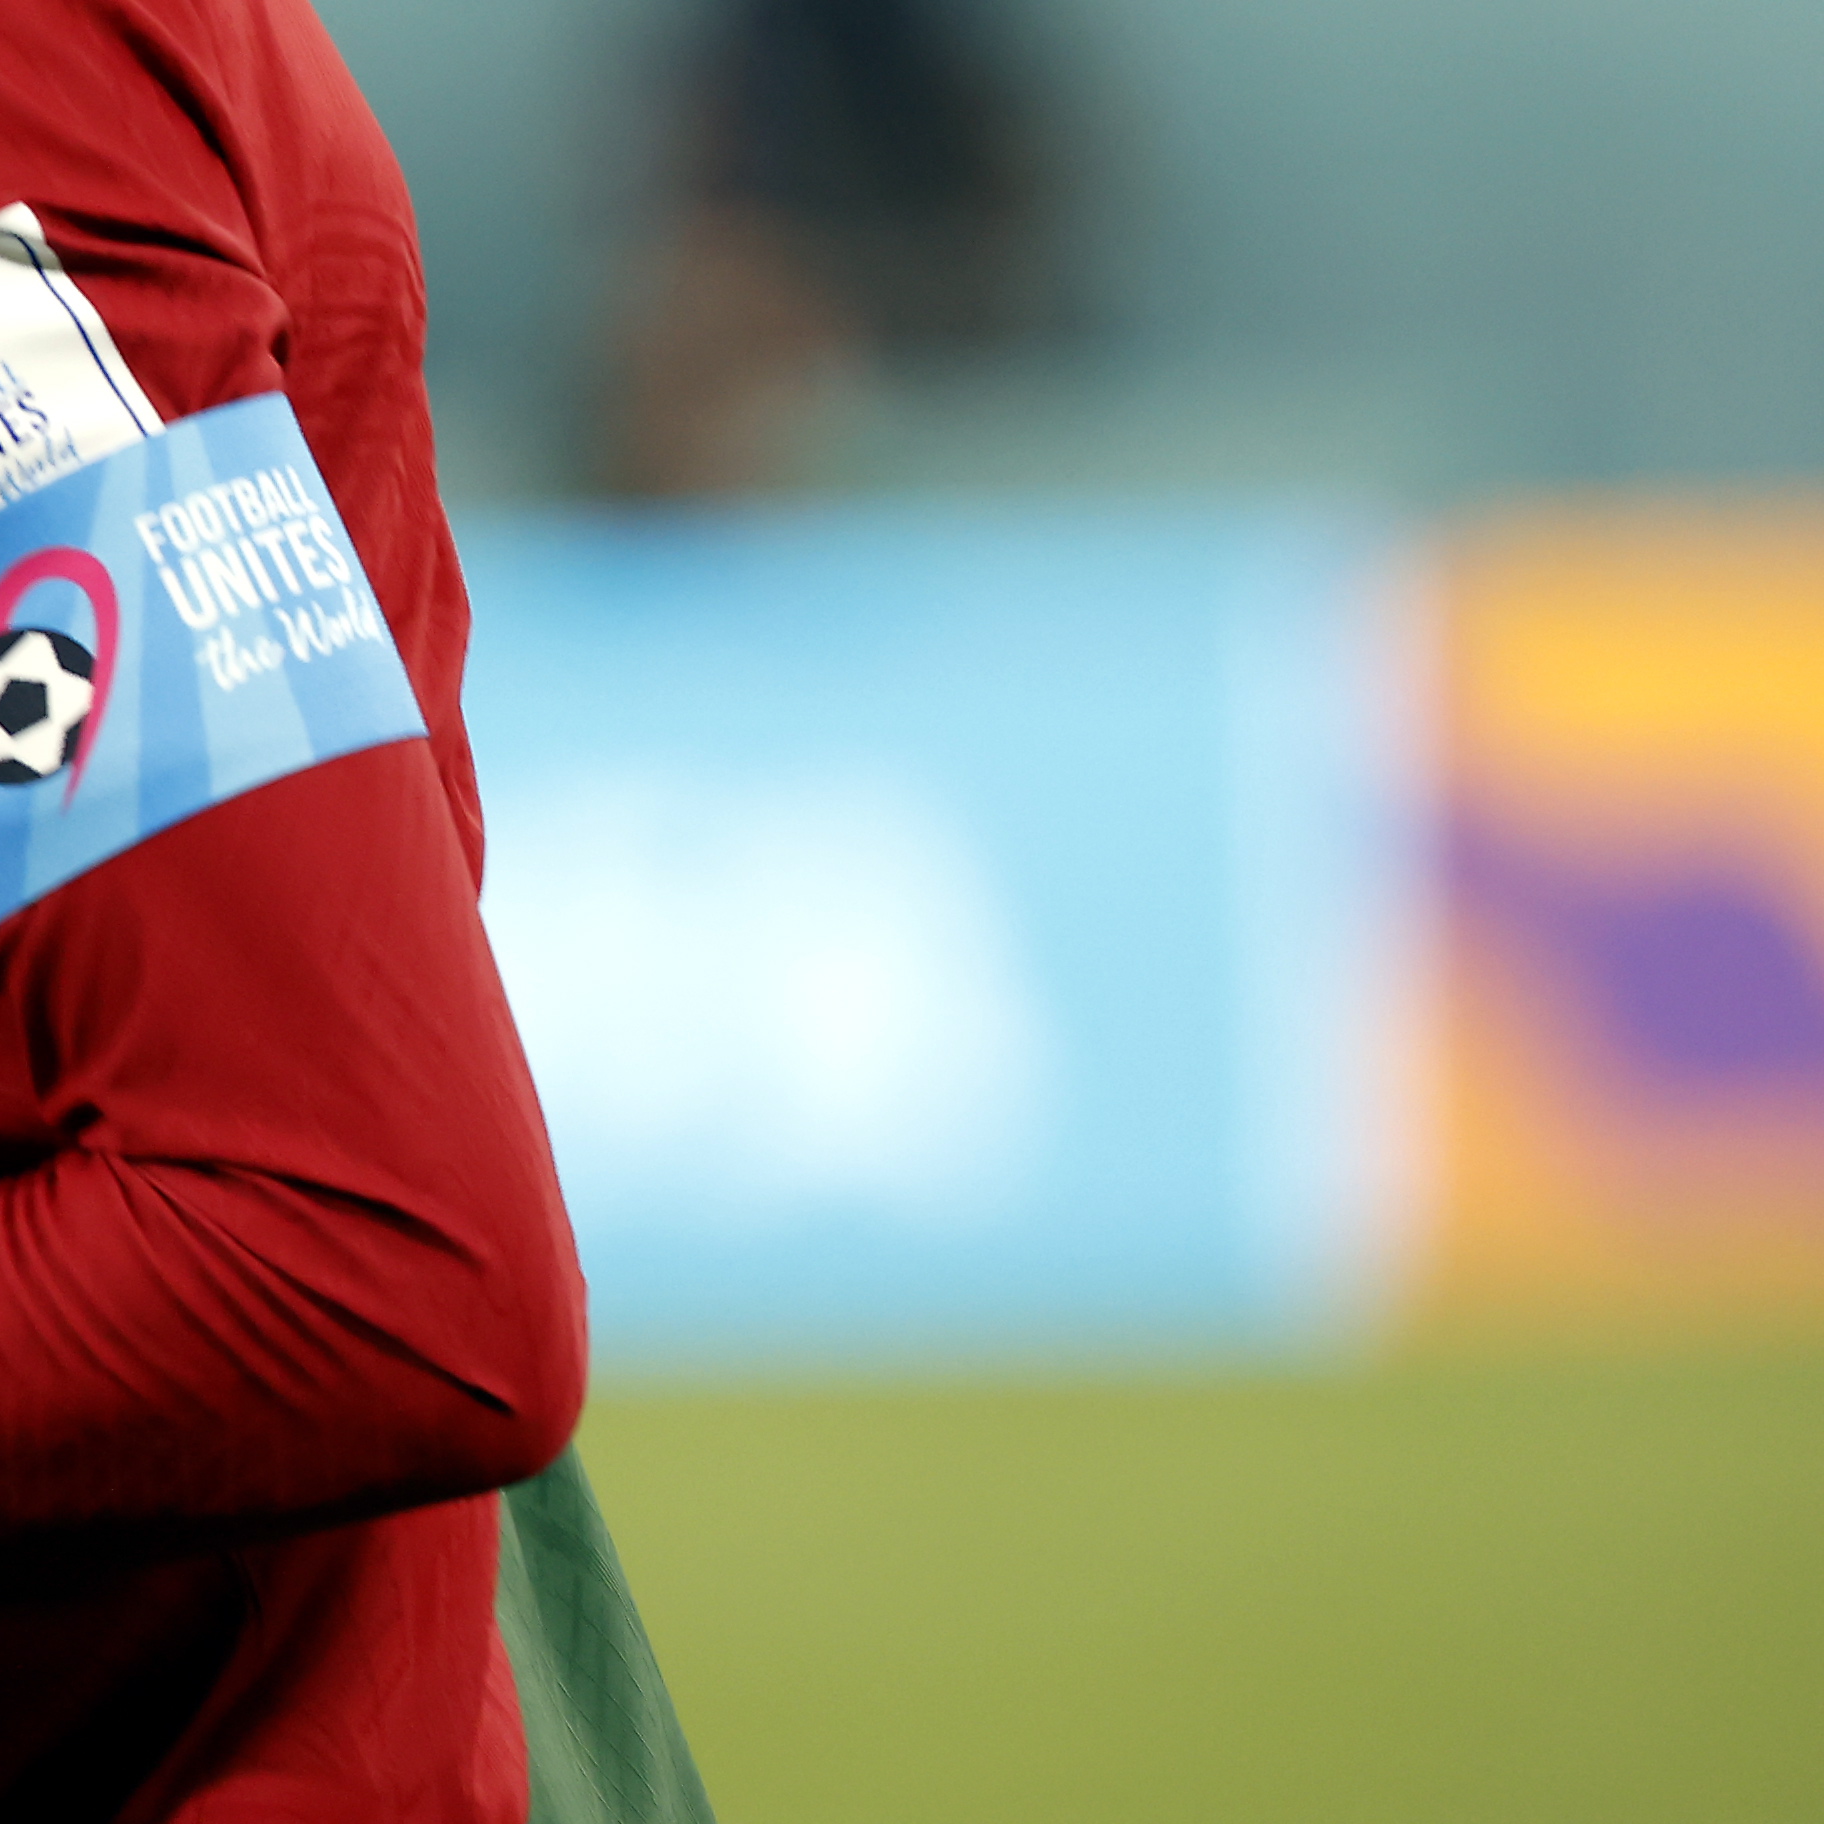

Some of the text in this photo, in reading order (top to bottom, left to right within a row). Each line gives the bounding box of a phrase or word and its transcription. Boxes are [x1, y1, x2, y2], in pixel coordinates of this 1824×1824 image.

[134, 463, 321, 565] FOOTBALL
[158, 513, 353, 632] UNITES
[194, 587, 387, 693] the World
